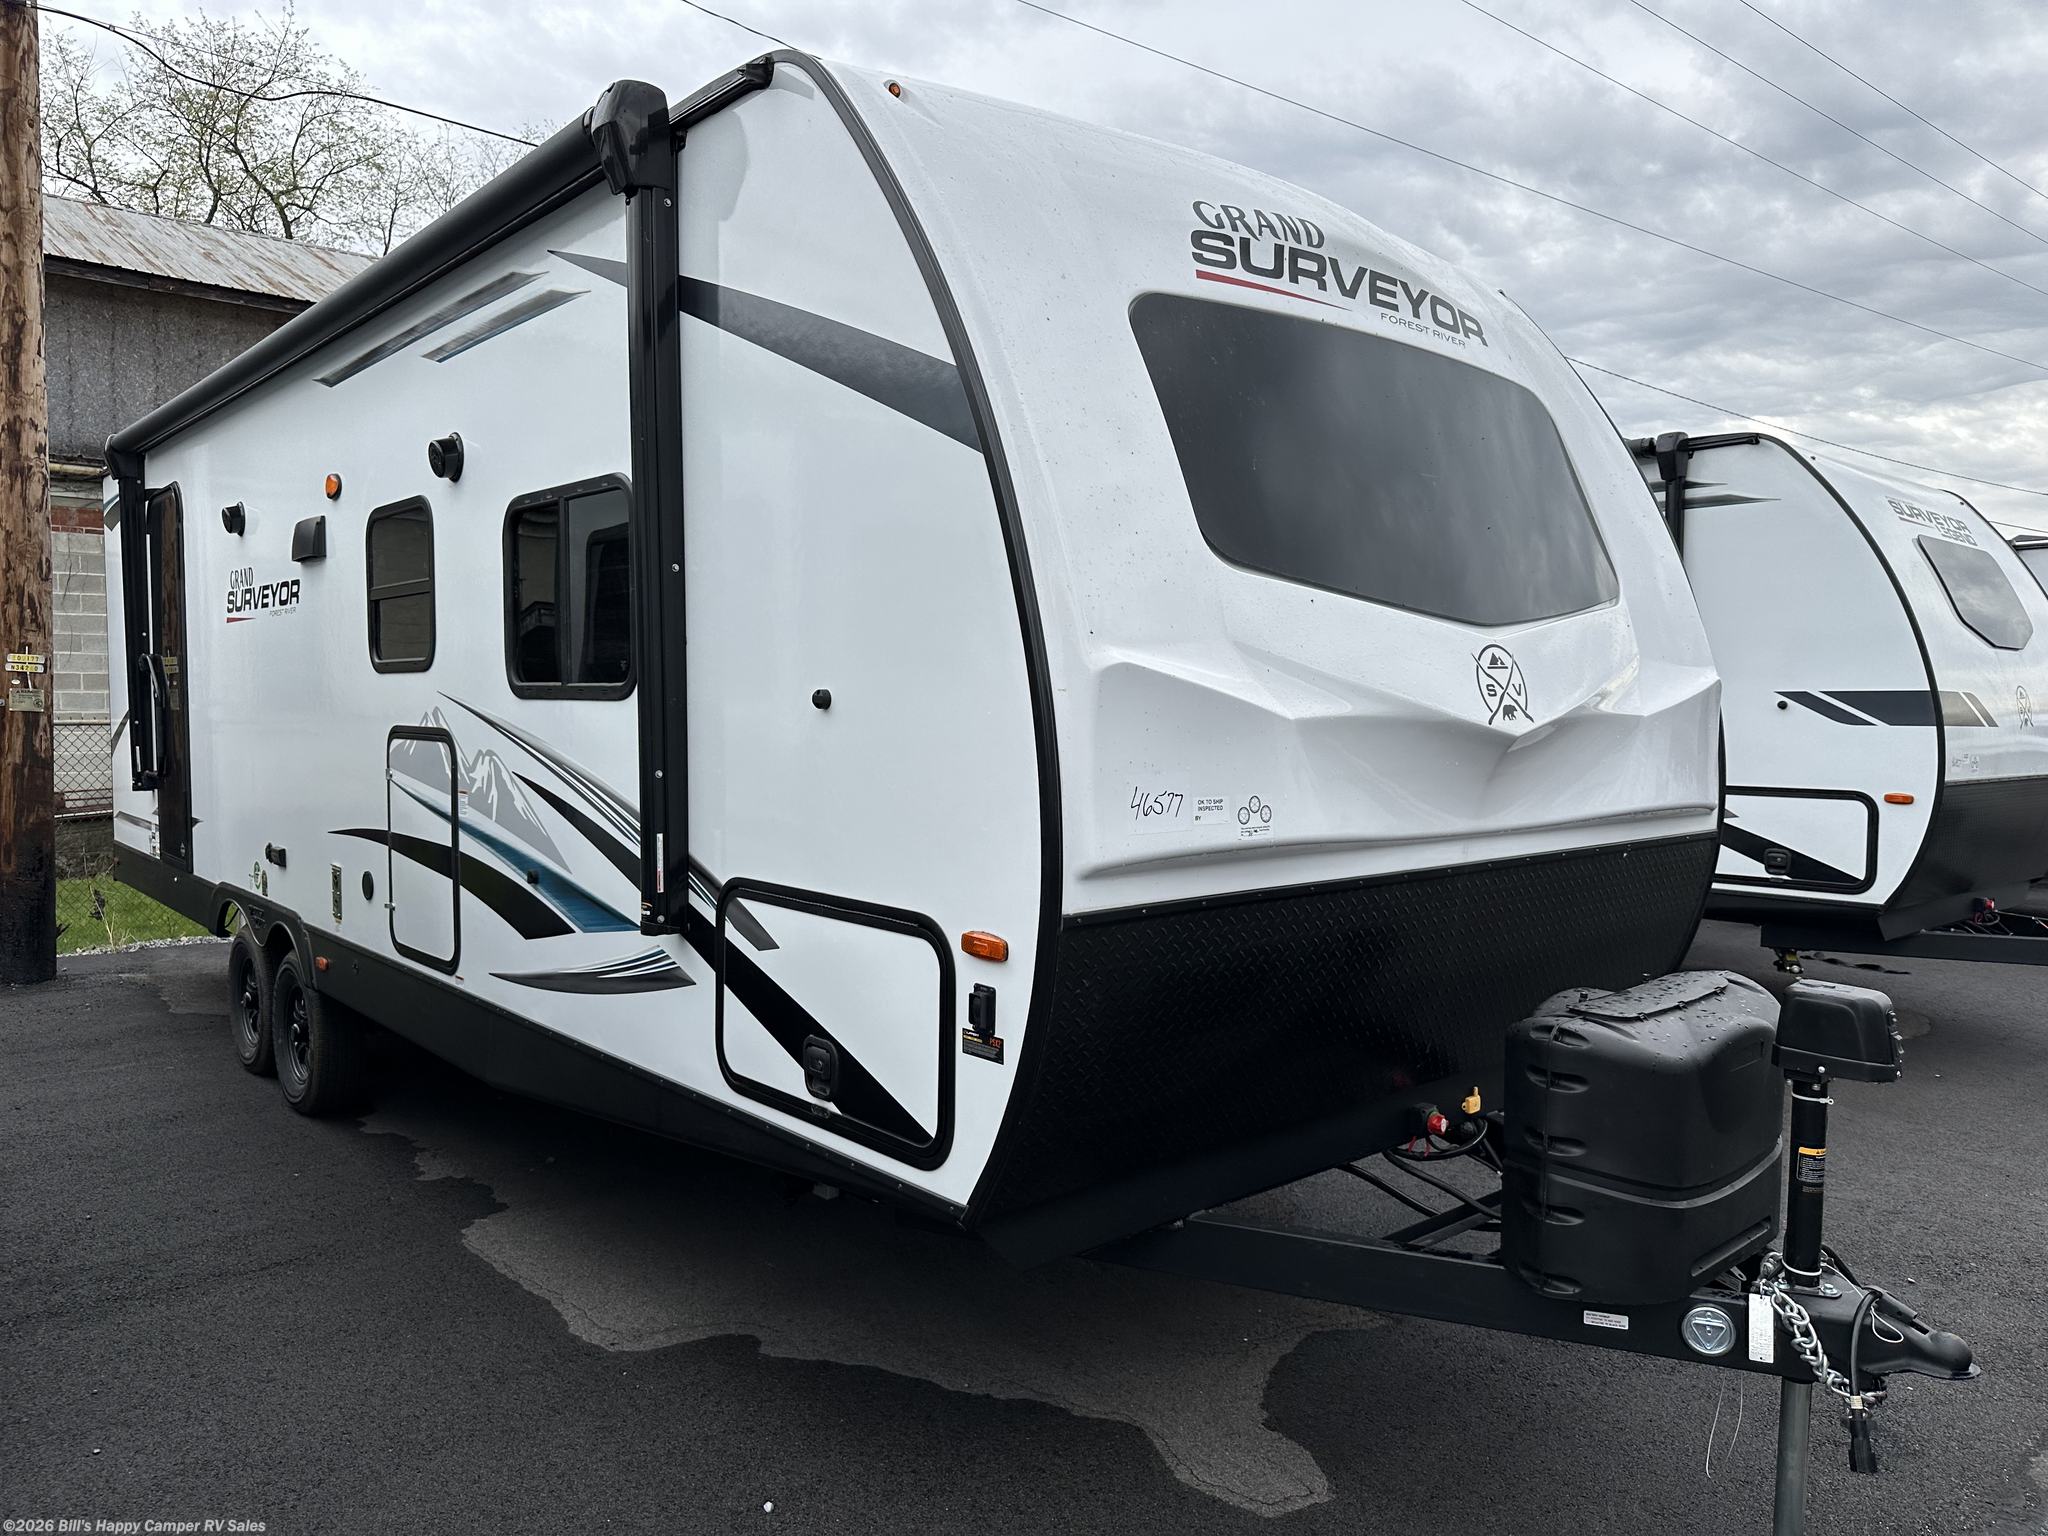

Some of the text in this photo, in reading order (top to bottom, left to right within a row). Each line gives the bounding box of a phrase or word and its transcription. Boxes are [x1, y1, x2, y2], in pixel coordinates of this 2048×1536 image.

[1192, 200, 1325, 249] GRAND
[1190, 229, 1489, 347] SURVEYOR
[1380, 312, 1466, 348] FOREST RIVER
[1887, 499, 1972, 534] SURVEYOR
[230, 567, 254, 590] GRAND
[226, 579, 300, 613] SURVEYOR
[269, 608, 284, 617] FOREST
[1486, 684, 1497, 697] S
[1130, 786, 1184, 820] 46577
